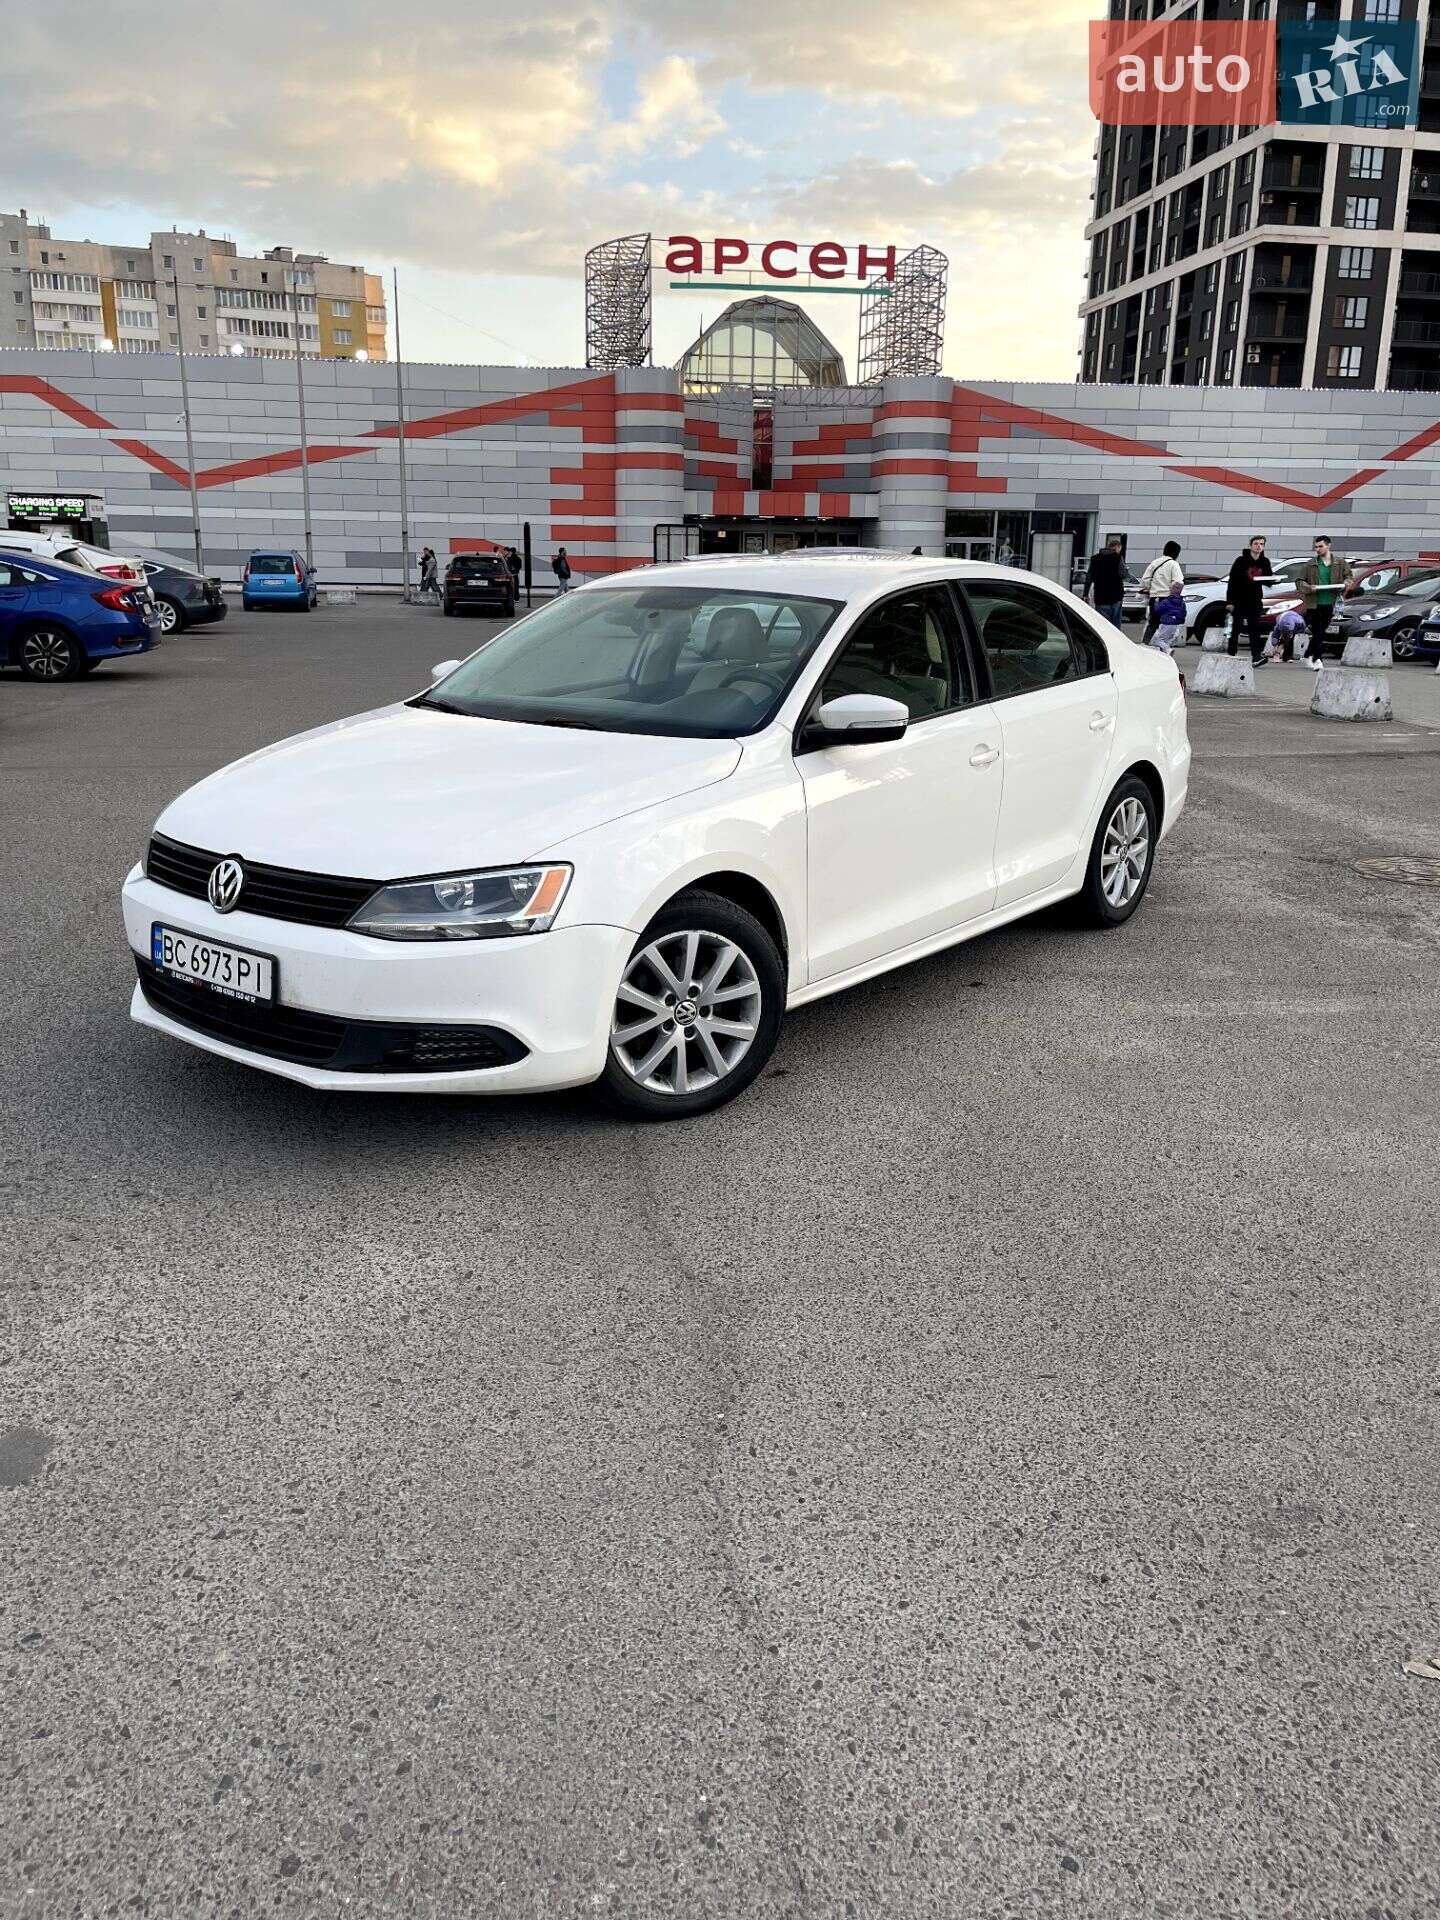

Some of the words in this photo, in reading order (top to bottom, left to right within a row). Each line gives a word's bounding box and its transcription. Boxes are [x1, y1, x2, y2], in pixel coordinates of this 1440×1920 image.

[9, 497, 54, 506] CHARGING
[55, 498, 84, 507] SPEED
[164, 935, 187, 967] BC
[191, 945, 232, 982] 6973
